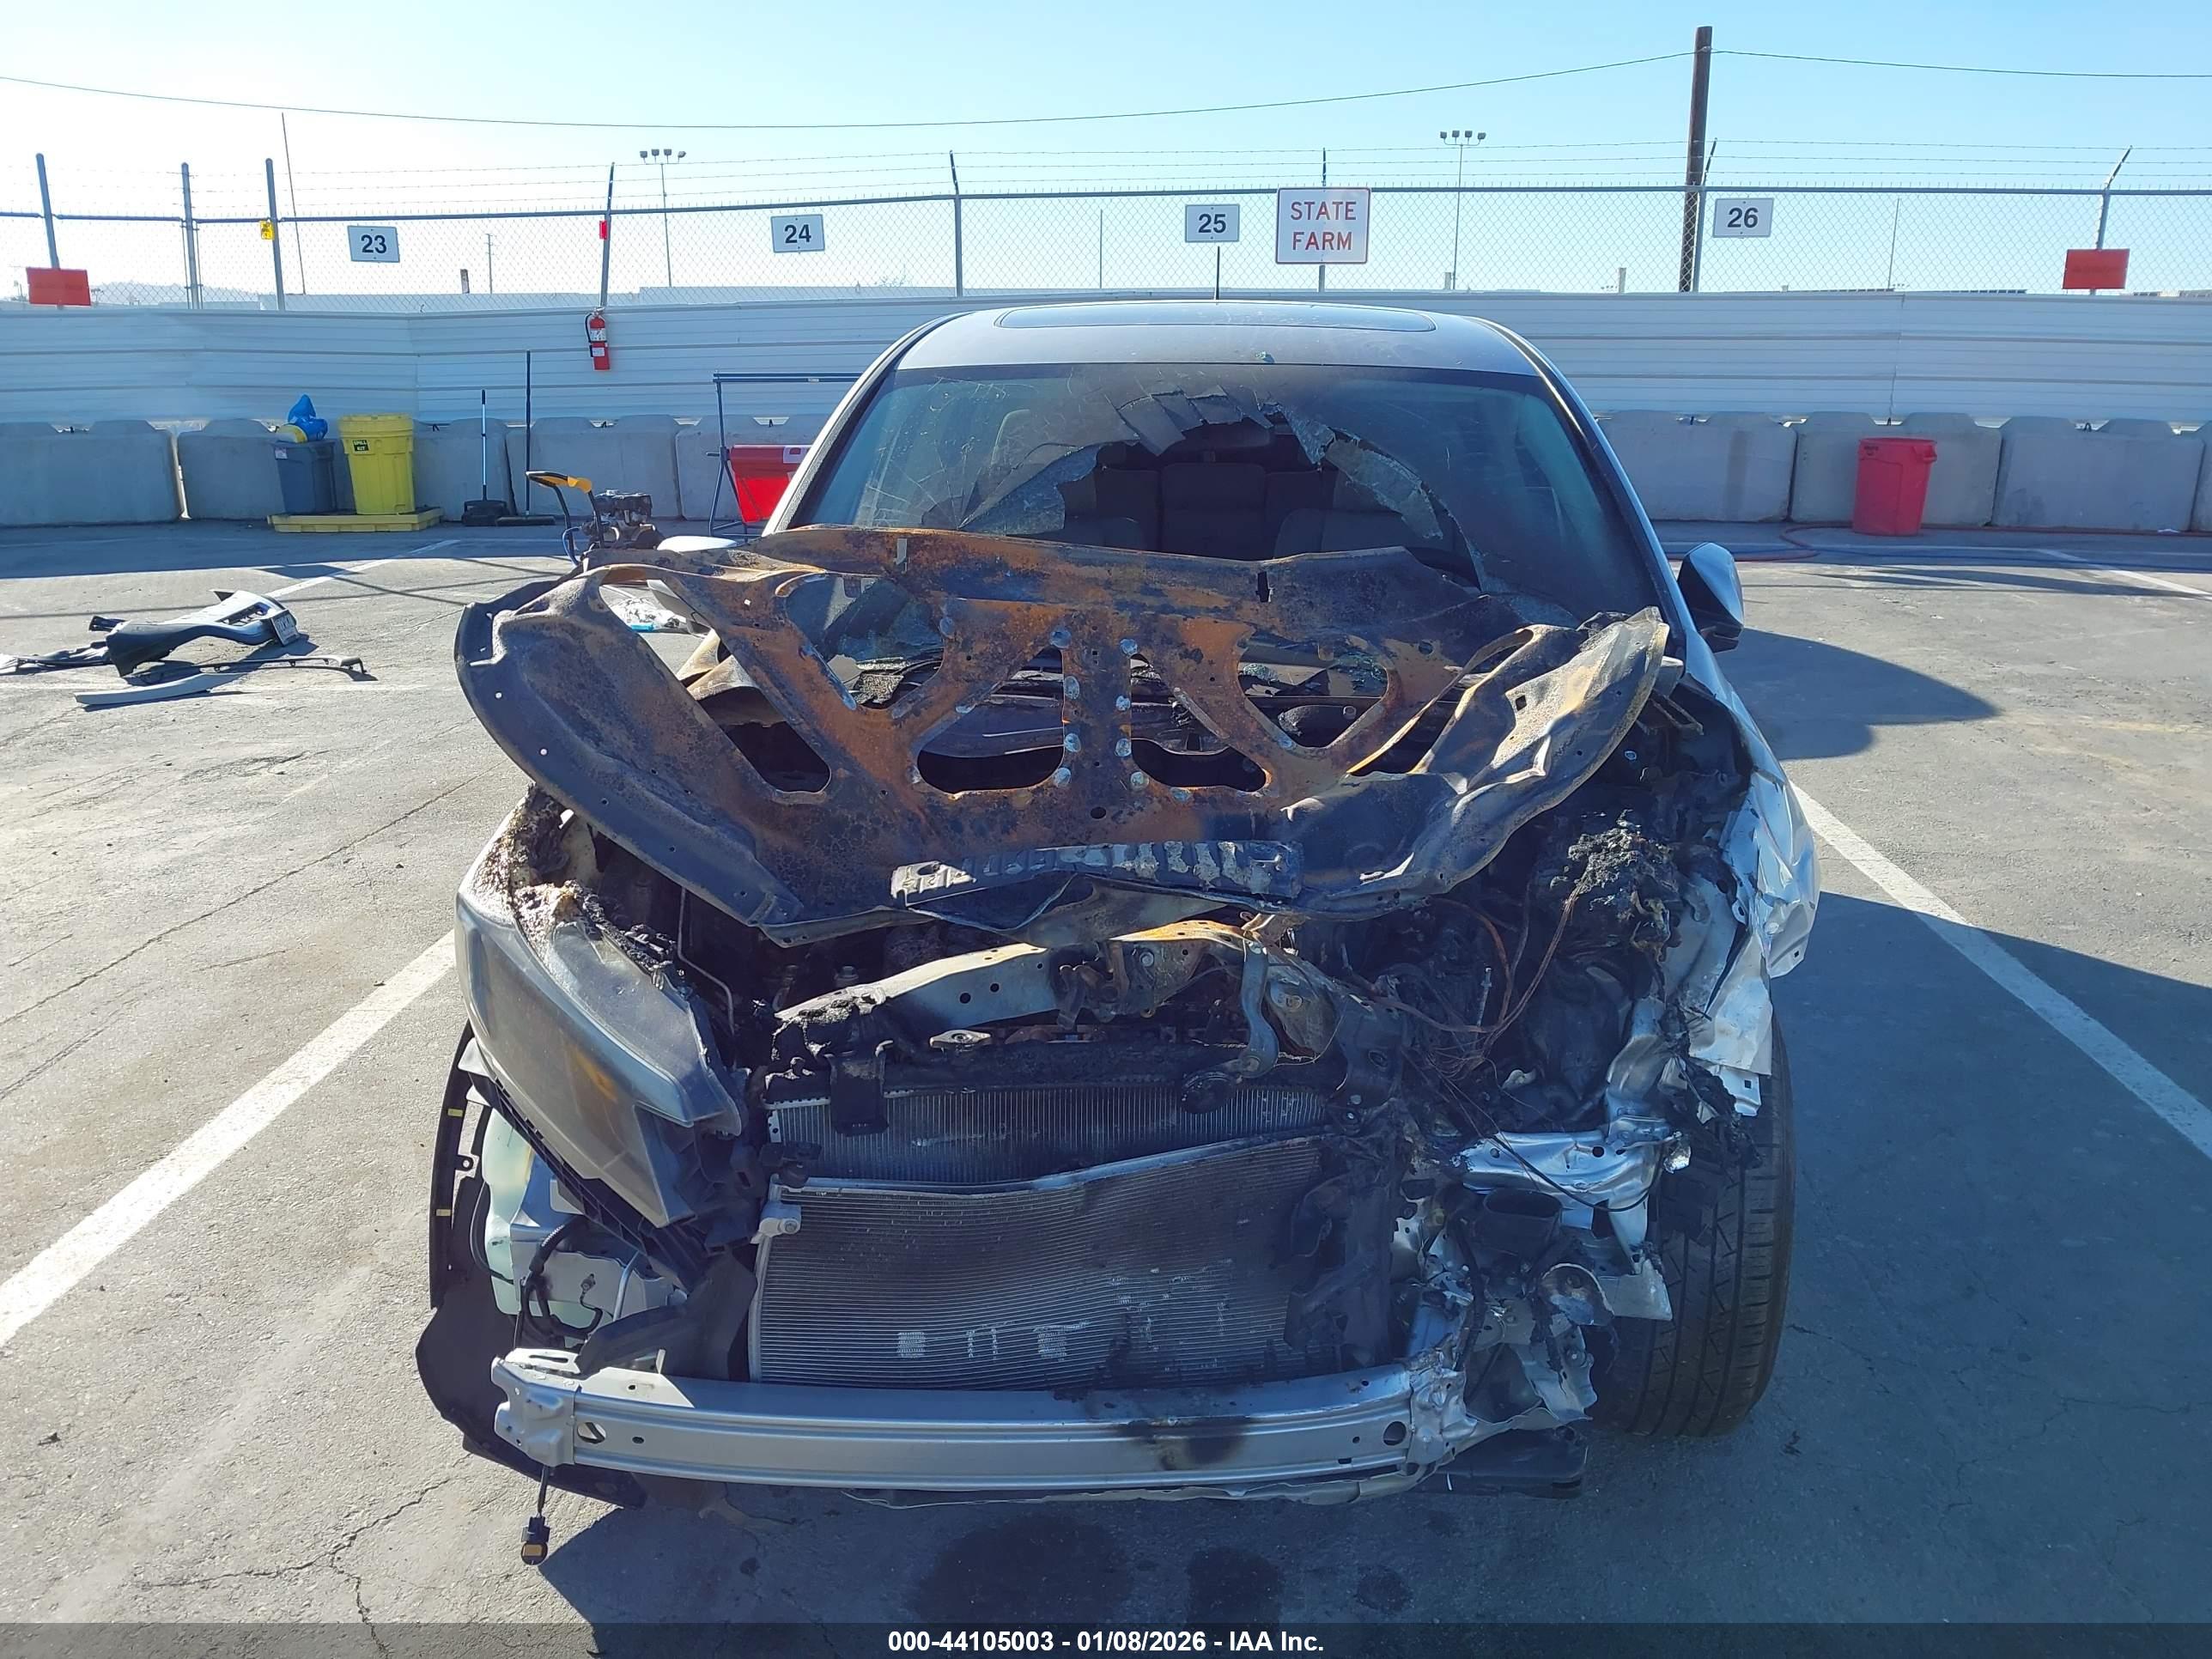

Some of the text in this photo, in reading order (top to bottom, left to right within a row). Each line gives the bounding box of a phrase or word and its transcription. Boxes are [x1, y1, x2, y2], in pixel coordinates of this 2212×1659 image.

[1291, 201, 1357, 221] STATE
[1727, 207, 1759, 228] 26
[784, 223, 812, 244] 24
[1198, 213, 1226, 234] 25
[361, 234, 387, 254] 23
[1292, 231, 1352, 251] FARM
